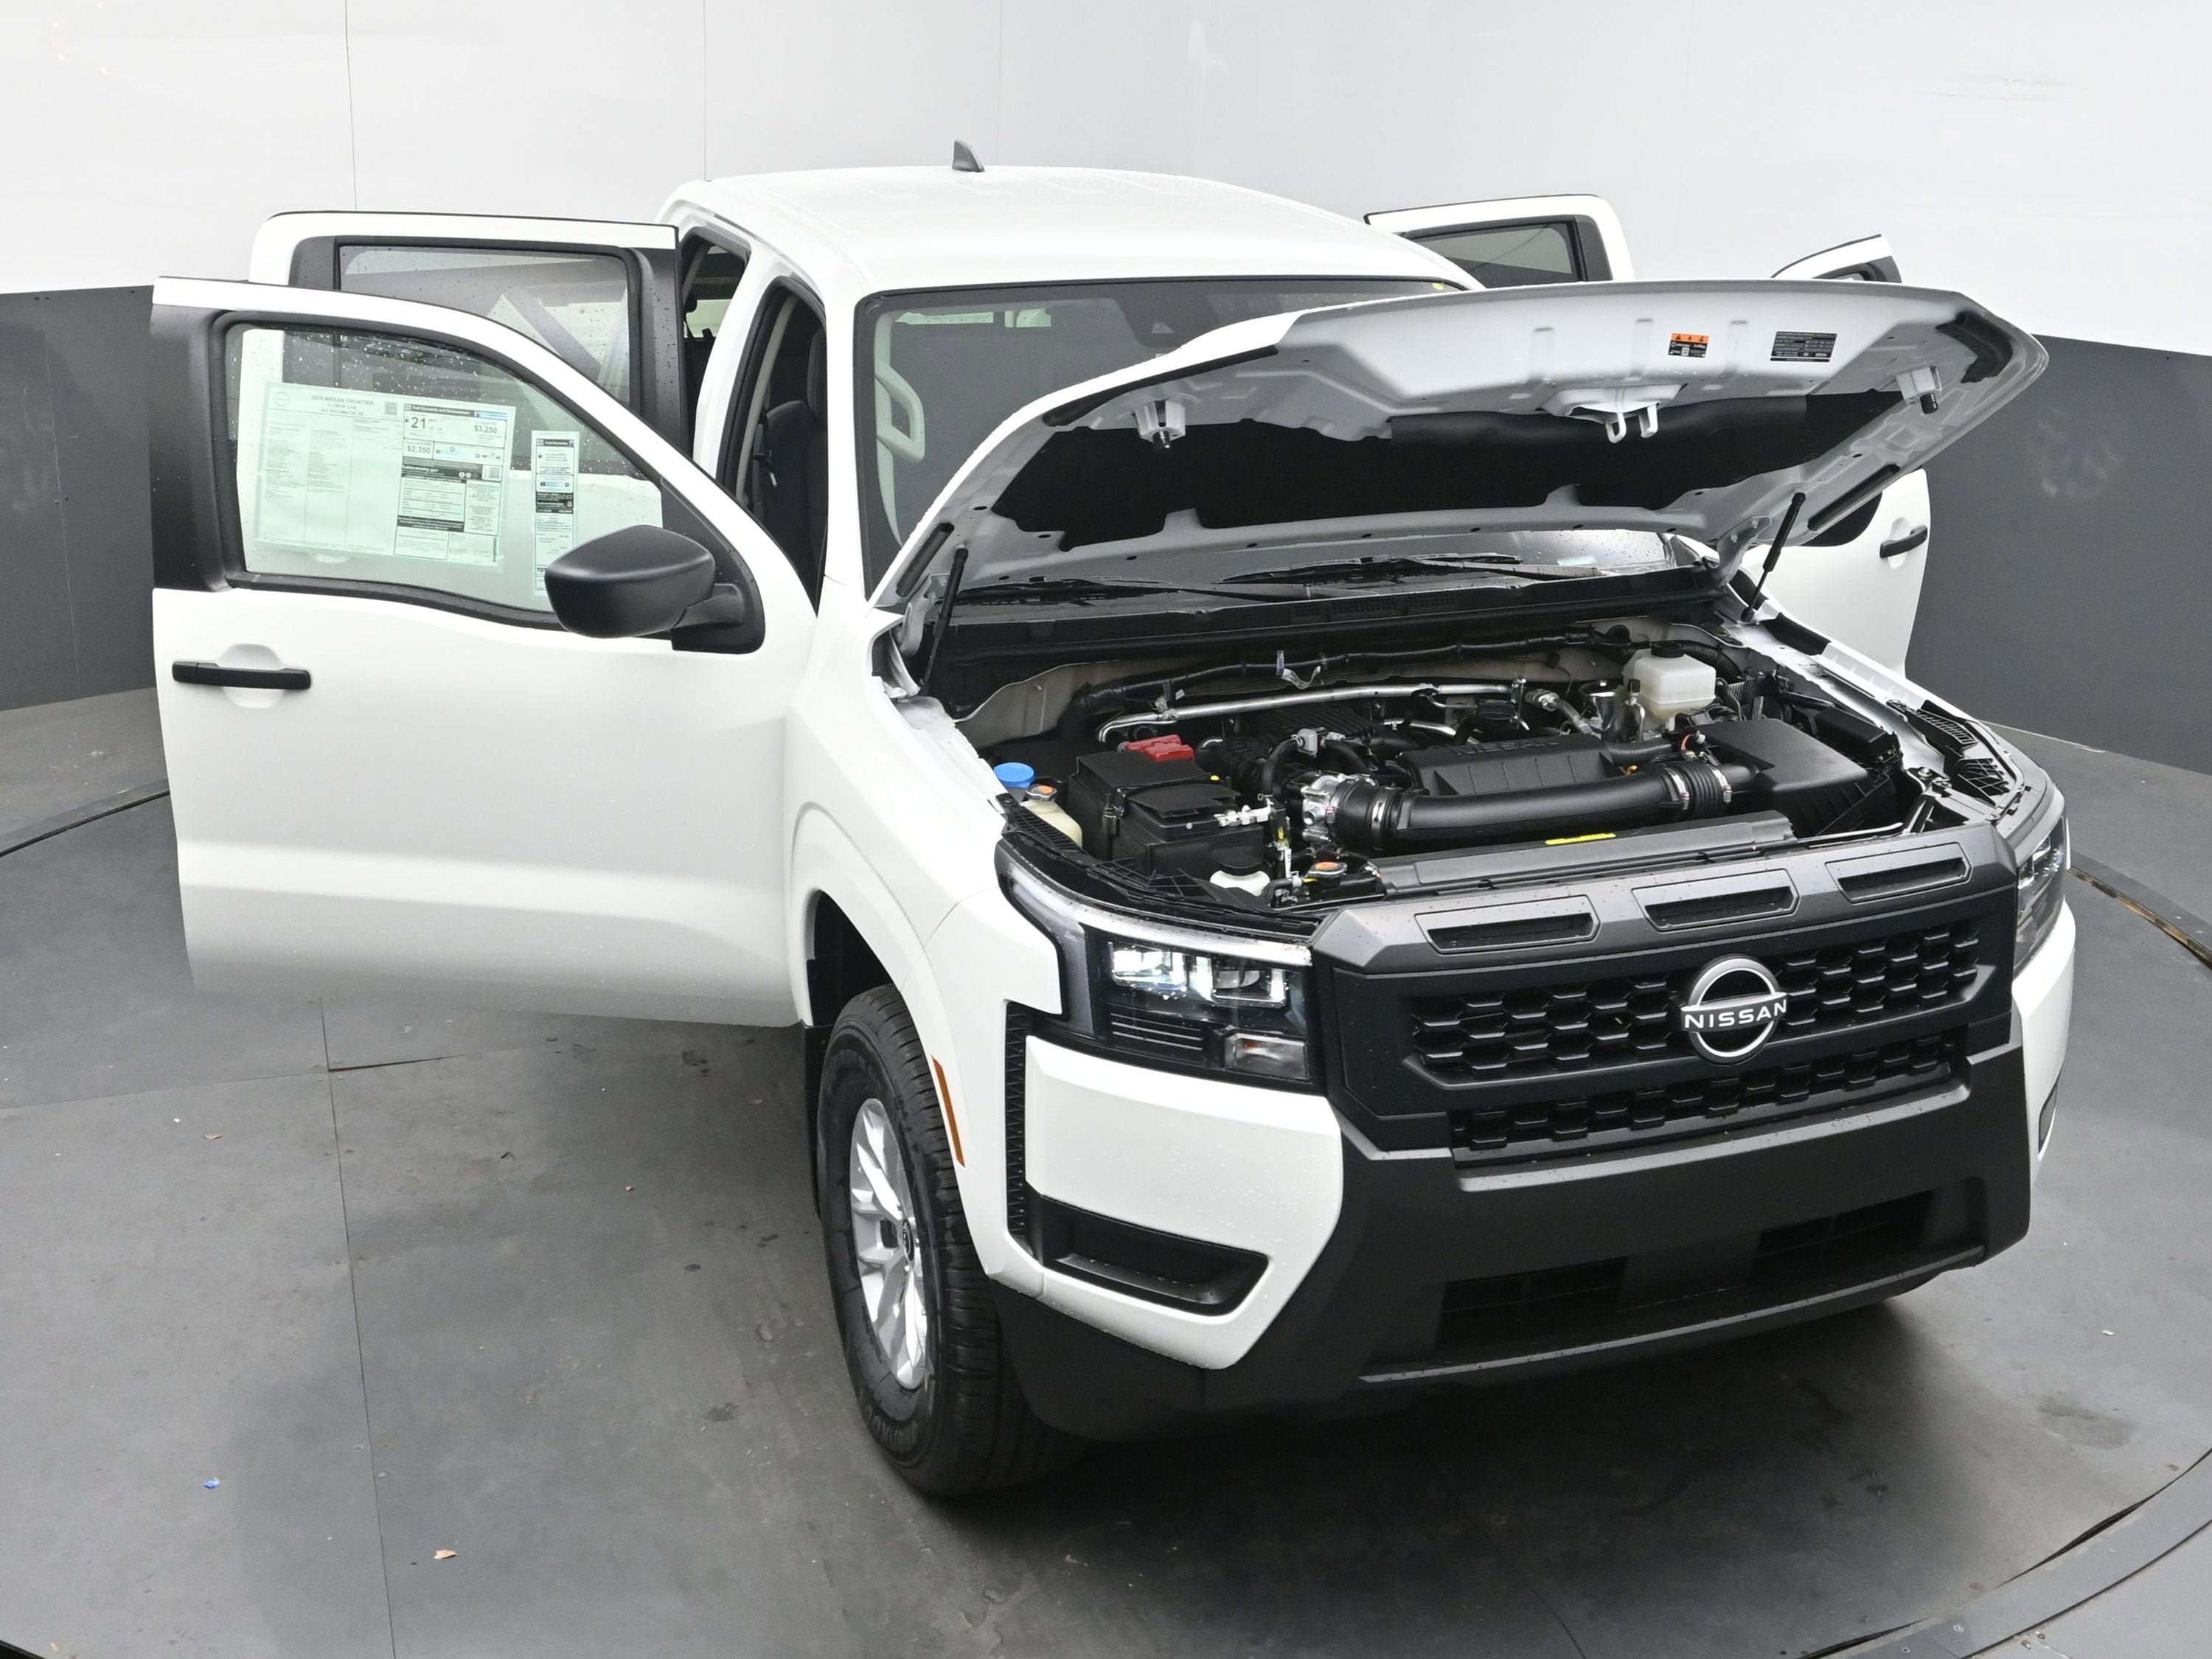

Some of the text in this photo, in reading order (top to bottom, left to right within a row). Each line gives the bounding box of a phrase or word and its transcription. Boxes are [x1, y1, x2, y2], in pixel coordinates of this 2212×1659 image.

[411, 417, 425, 429] 21
[407, 445, 431, 453] $2,350
[1684, 999, 1787, 1029] NISSAN
